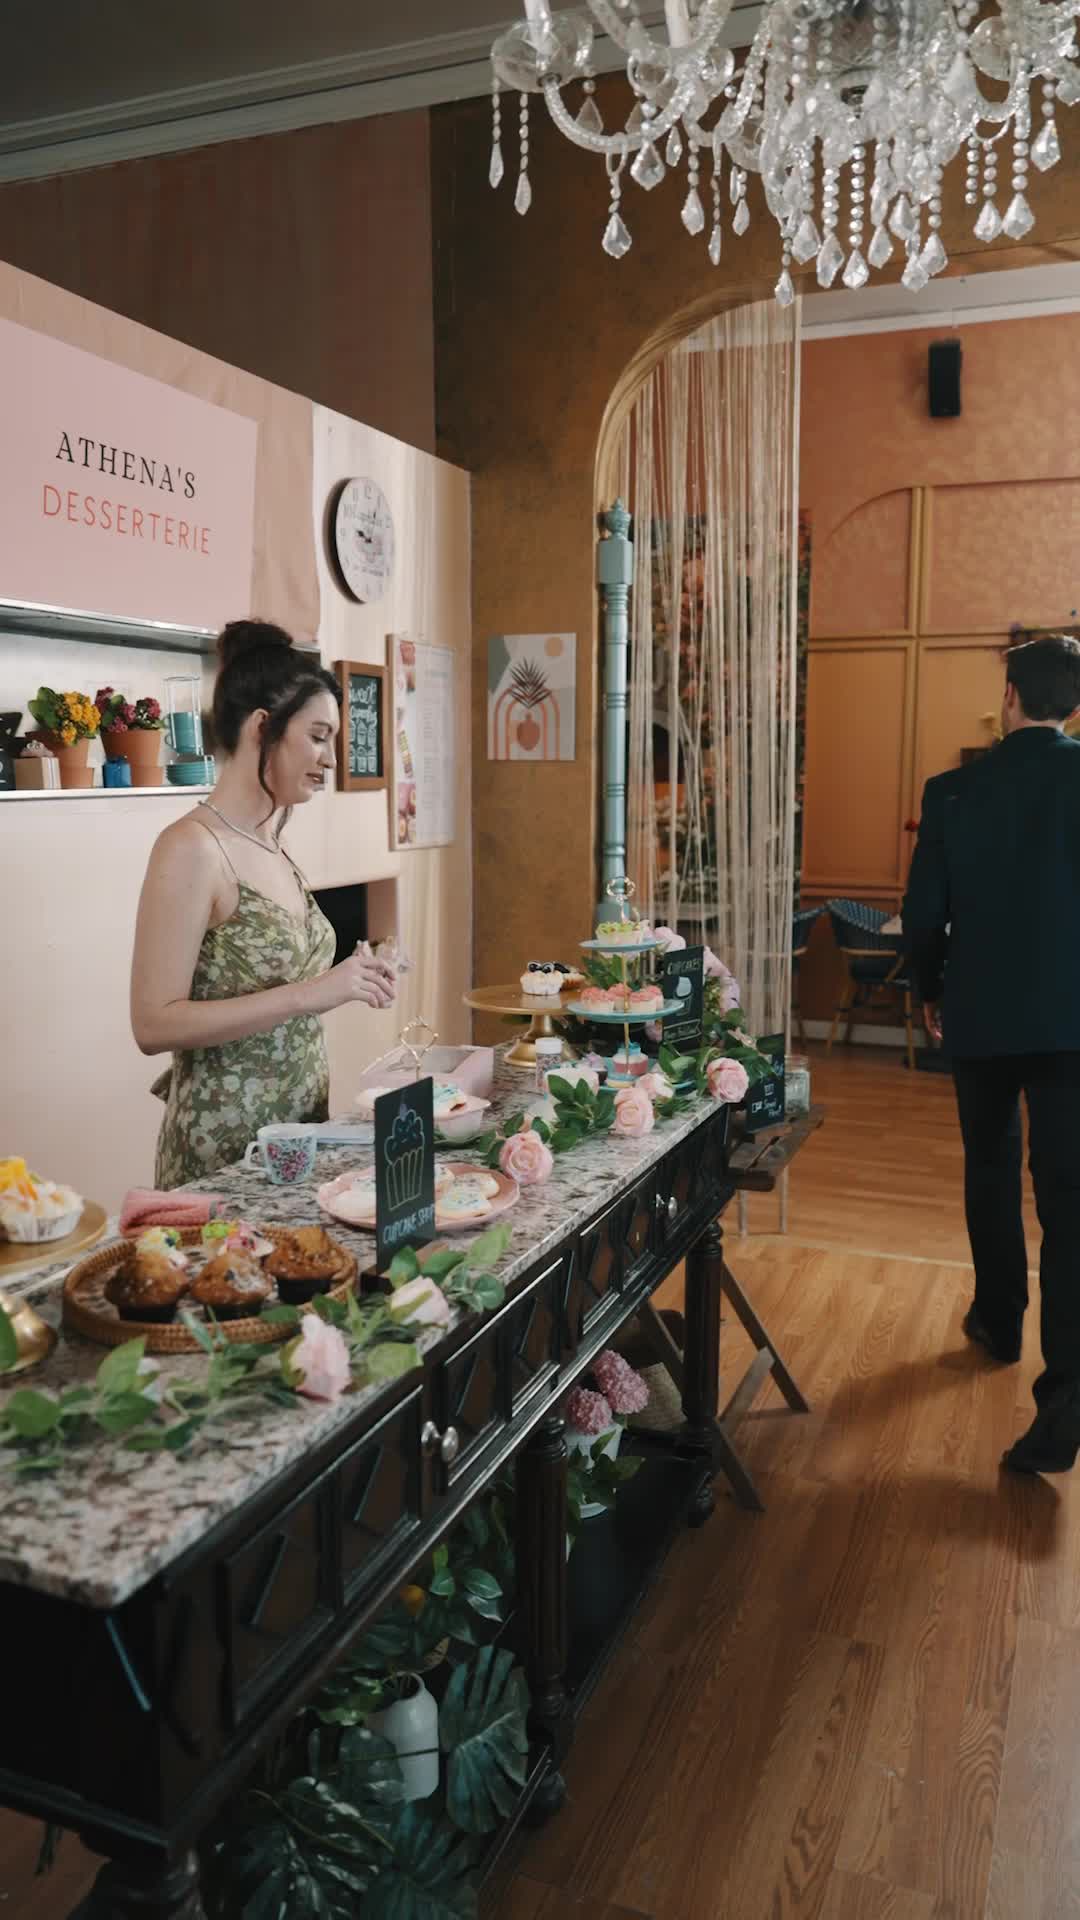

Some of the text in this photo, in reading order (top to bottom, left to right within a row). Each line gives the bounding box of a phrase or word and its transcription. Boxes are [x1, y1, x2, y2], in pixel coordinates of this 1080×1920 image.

[55, 431, 196, 499] ATHENA'S
[43, 484, 212, 554] DESSERTERIE
[383, 1212, 417, 1244] CUPCAKE
